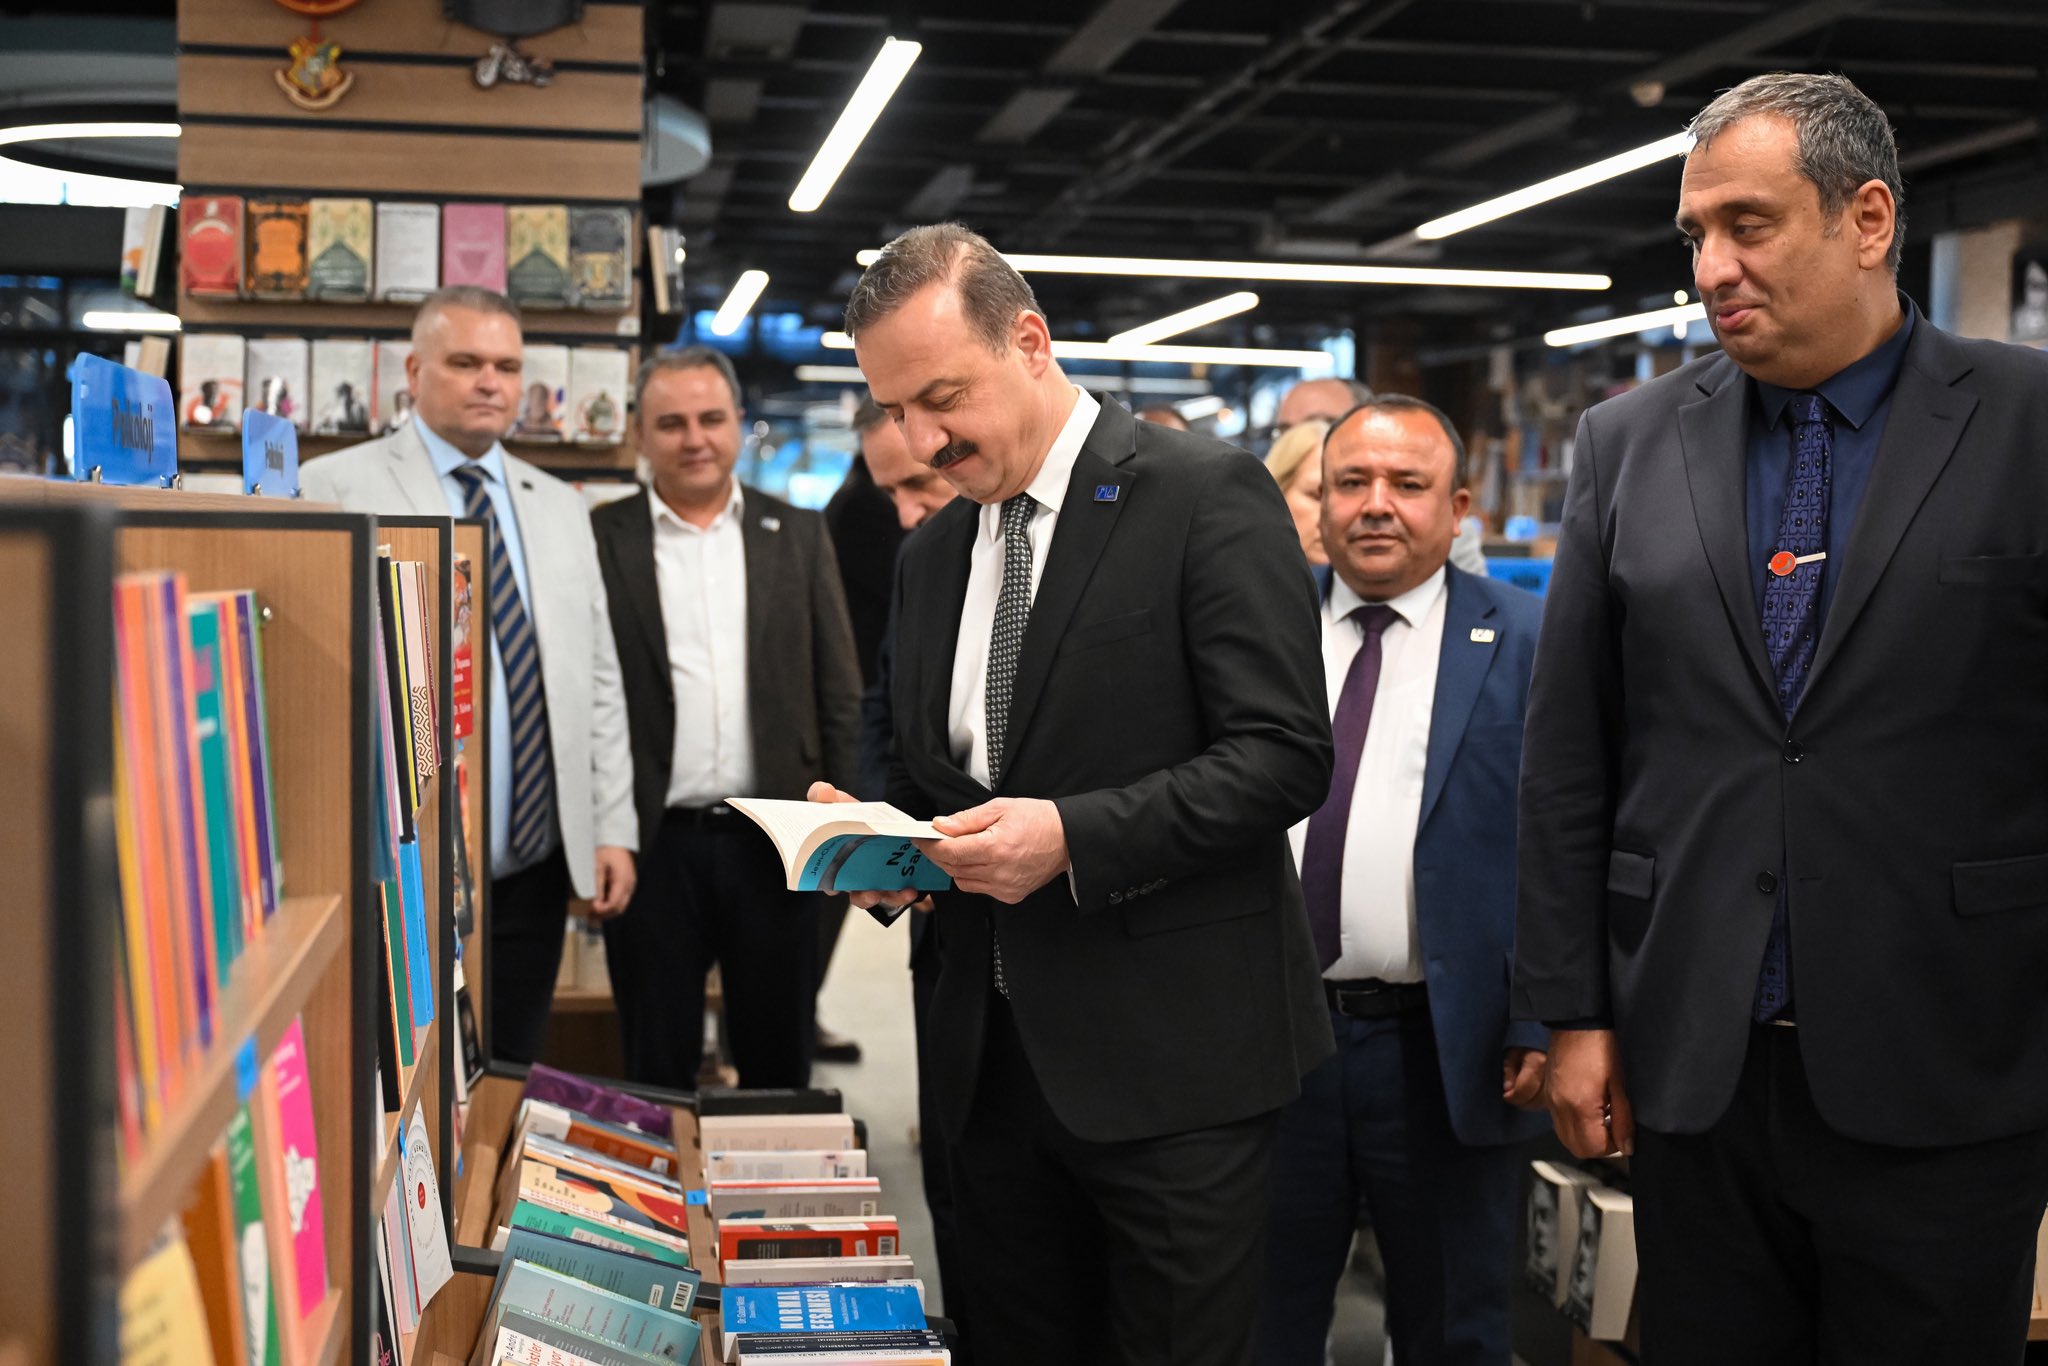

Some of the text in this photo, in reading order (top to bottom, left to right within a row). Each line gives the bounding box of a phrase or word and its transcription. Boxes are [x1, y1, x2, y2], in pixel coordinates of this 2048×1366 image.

[112, 397, 153, 464] Psikoloji
[885, 839, 912, 866] Na
[522, 1308, 595, 1338] MARSHMALLOW
[777, 1290, 804, 1329] NORMAL
[802, 1290, 835, 1329] EFSANESİ
